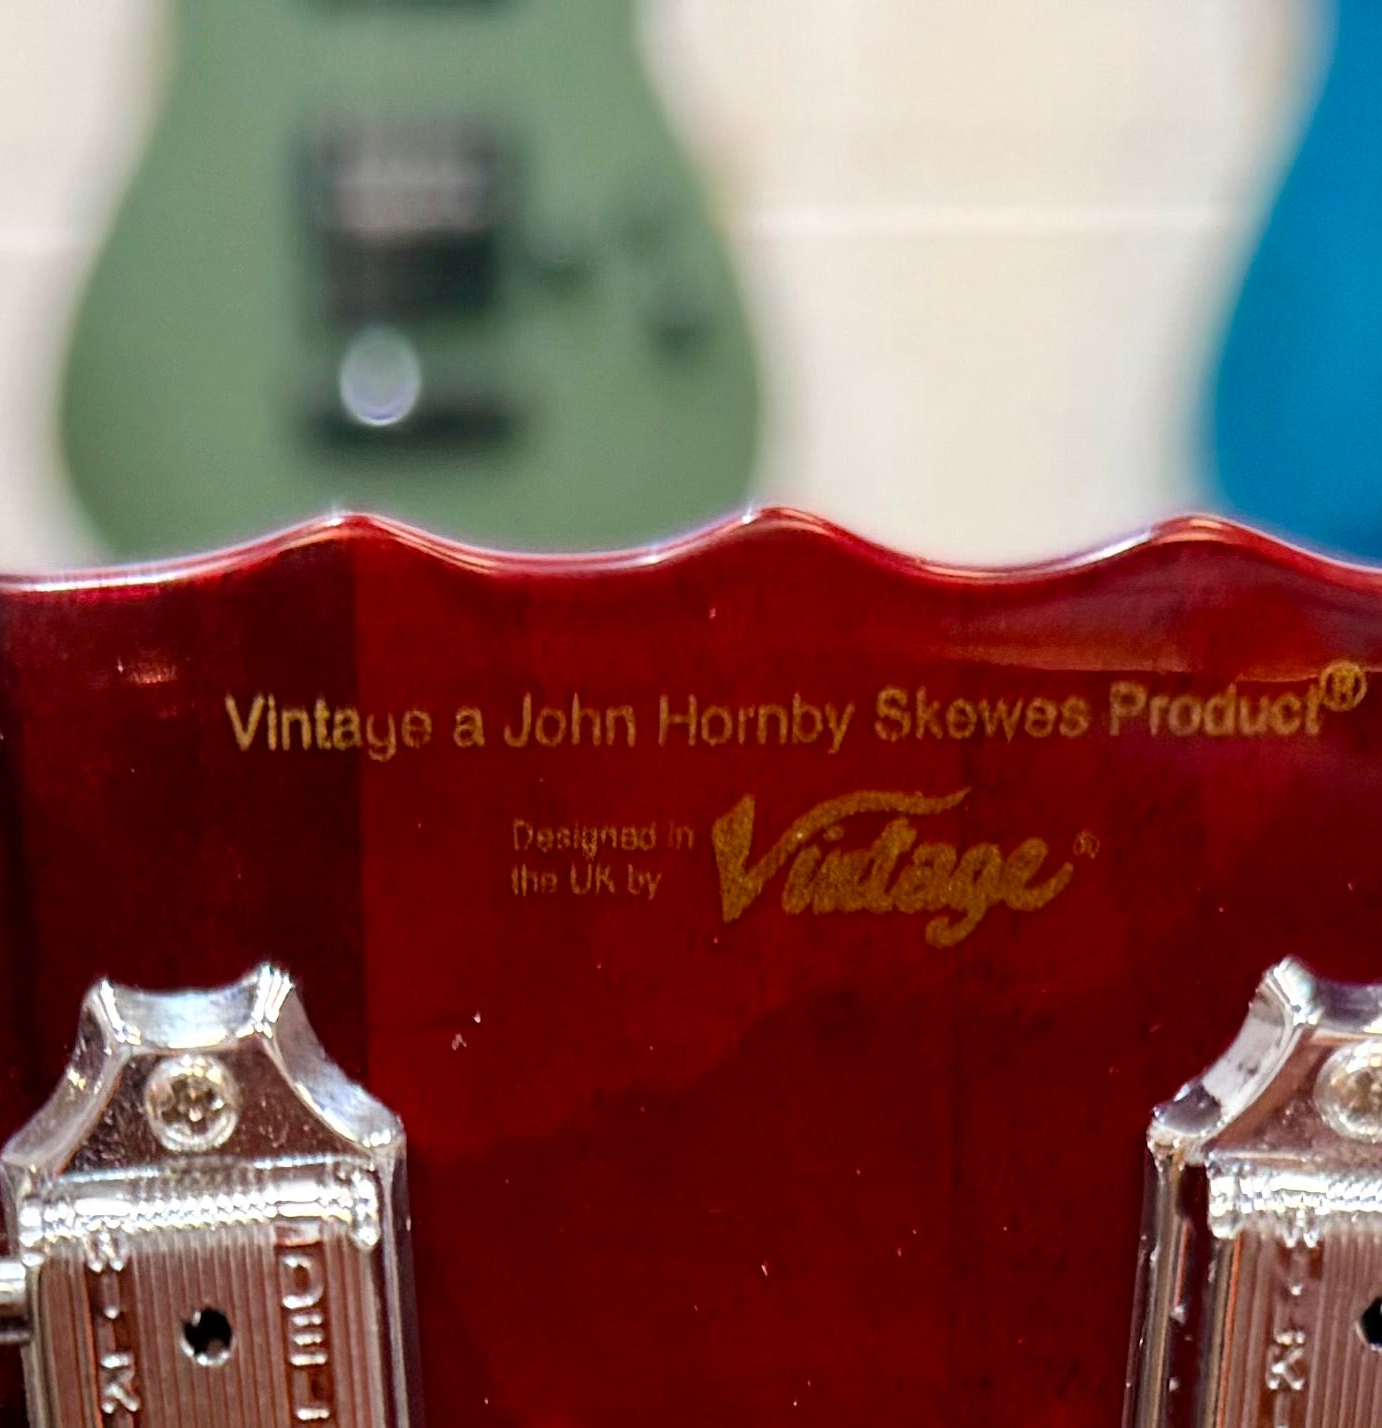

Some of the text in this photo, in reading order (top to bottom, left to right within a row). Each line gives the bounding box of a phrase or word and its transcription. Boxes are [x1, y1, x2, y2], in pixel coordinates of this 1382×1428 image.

[225, 694, 432, 761] Vintage
[454, 708, 485, 747] a
[504, 694, 636, 747] John
[659, 693, 854, 753] Hornby
[875, 687, 1089, 741] Skewes
[512, 818, 657, 859] Designed
[510, 861, 662, 900] the UK by
